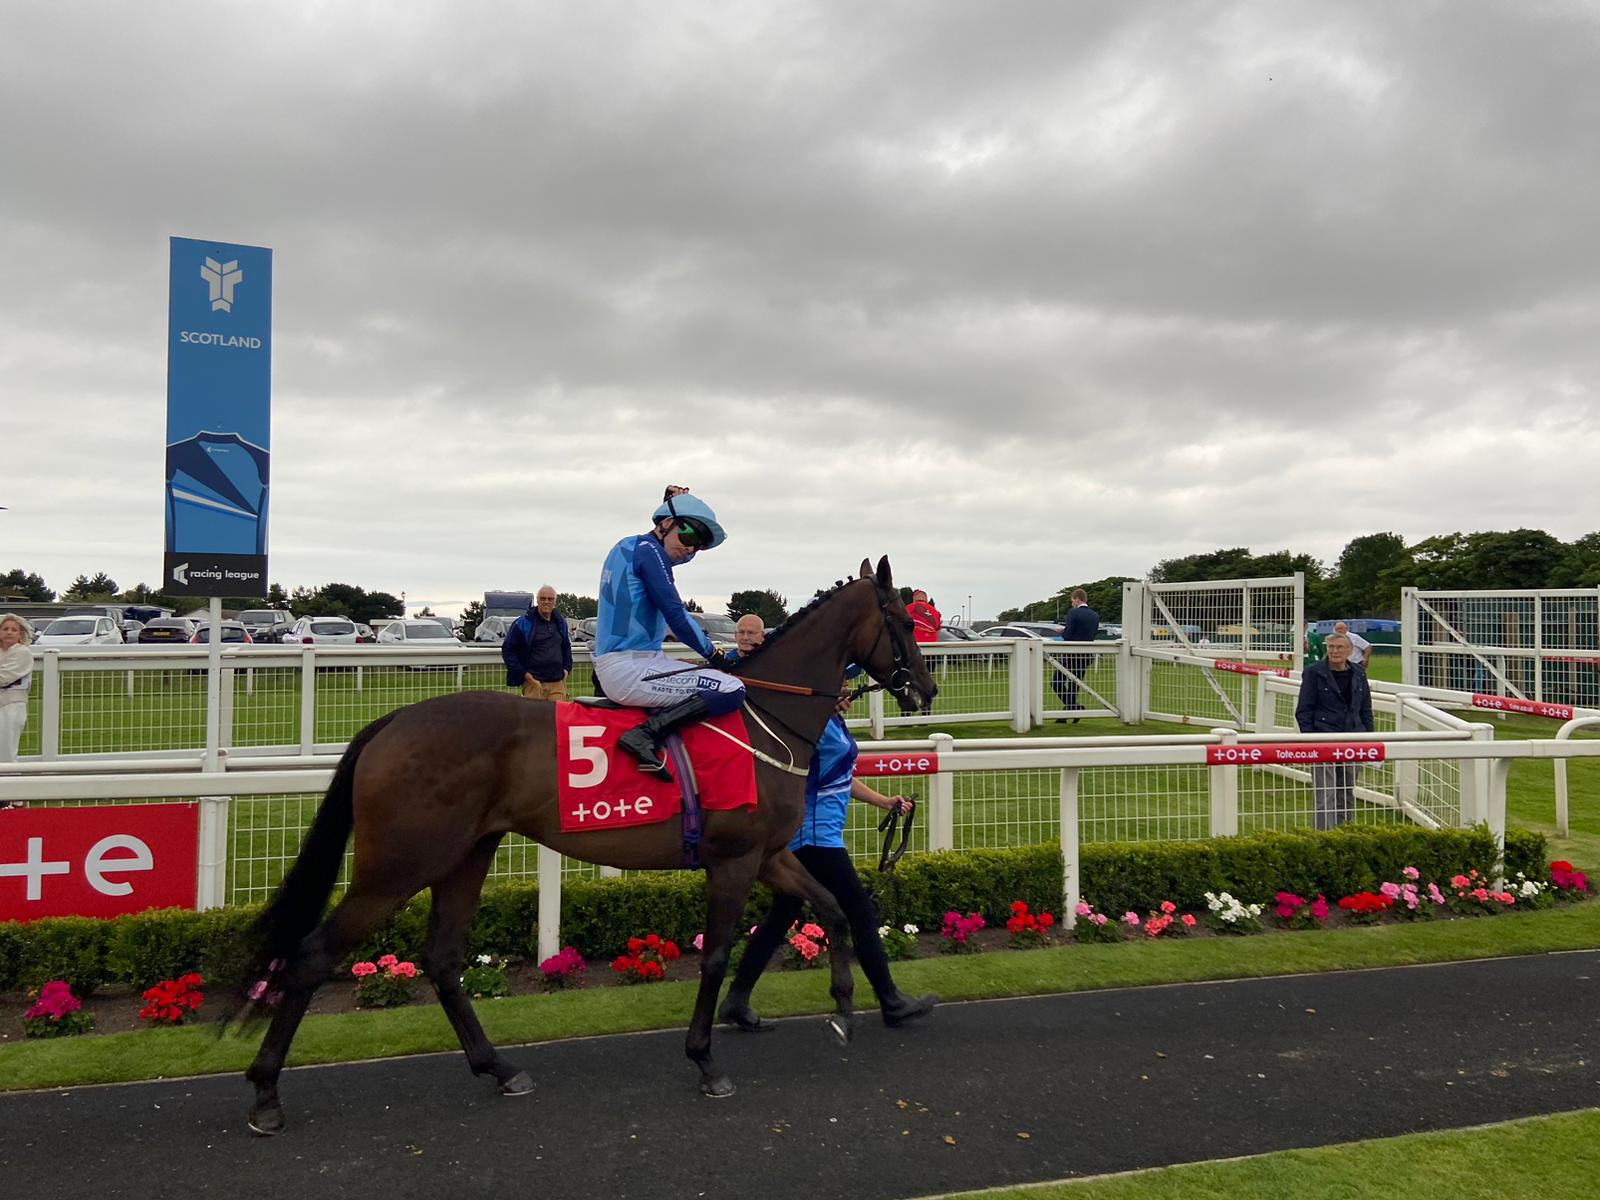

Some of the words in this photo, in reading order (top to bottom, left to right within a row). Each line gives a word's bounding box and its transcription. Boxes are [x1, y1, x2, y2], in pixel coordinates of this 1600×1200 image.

[180, 331, 261, 349] SCOTLAND
[190, 569, 222, 580] racing
[225, 569, 260, 581] league
[1475, 698, 1503, 709] tote
[1541, 706, 1569, 719] tote
[568, 725, 609, 788] 5
[1214, 748, 1262, 761] tote
[1276, 749, 1319, 760] Tote.co.uk
[1332, 747, 1379, 760] tote
[874, 757, 931, 772] tote
[571, 796, 654, 822] tote
